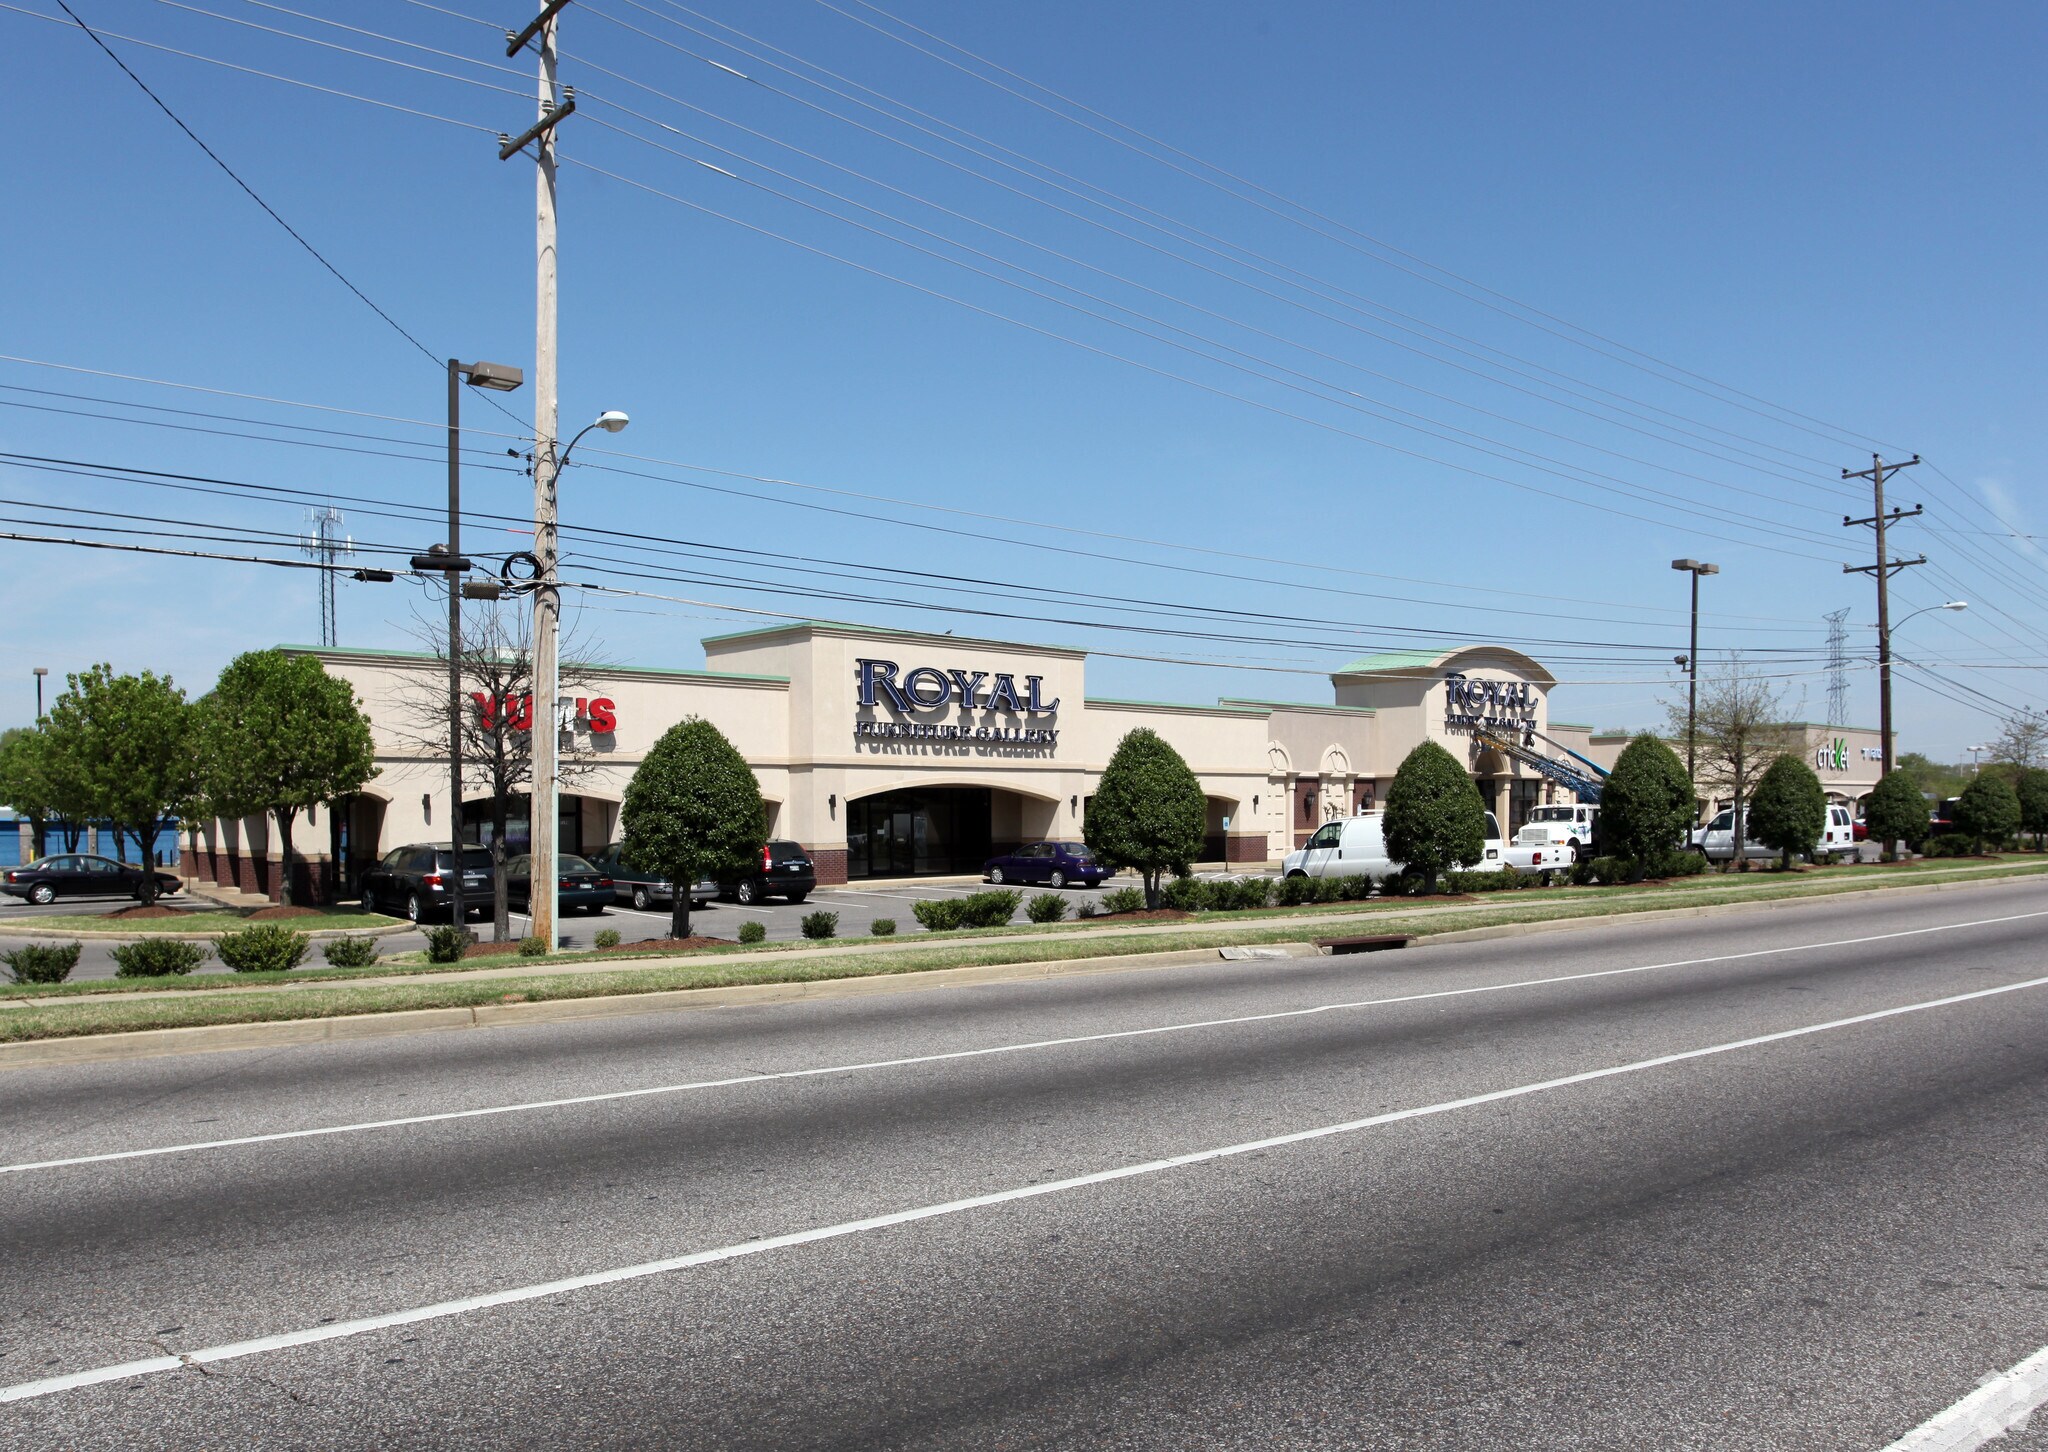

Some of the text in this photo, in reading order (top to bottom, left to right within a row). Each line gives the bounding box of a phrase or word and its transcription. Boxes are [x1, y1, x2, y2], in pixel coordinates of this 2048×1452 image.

[855, 658, 1060, 713] ROYAL
[1446, 673, 1539, 709] ROYAL
[856, 720, 1060, 744] FURNITURE GALLERY
